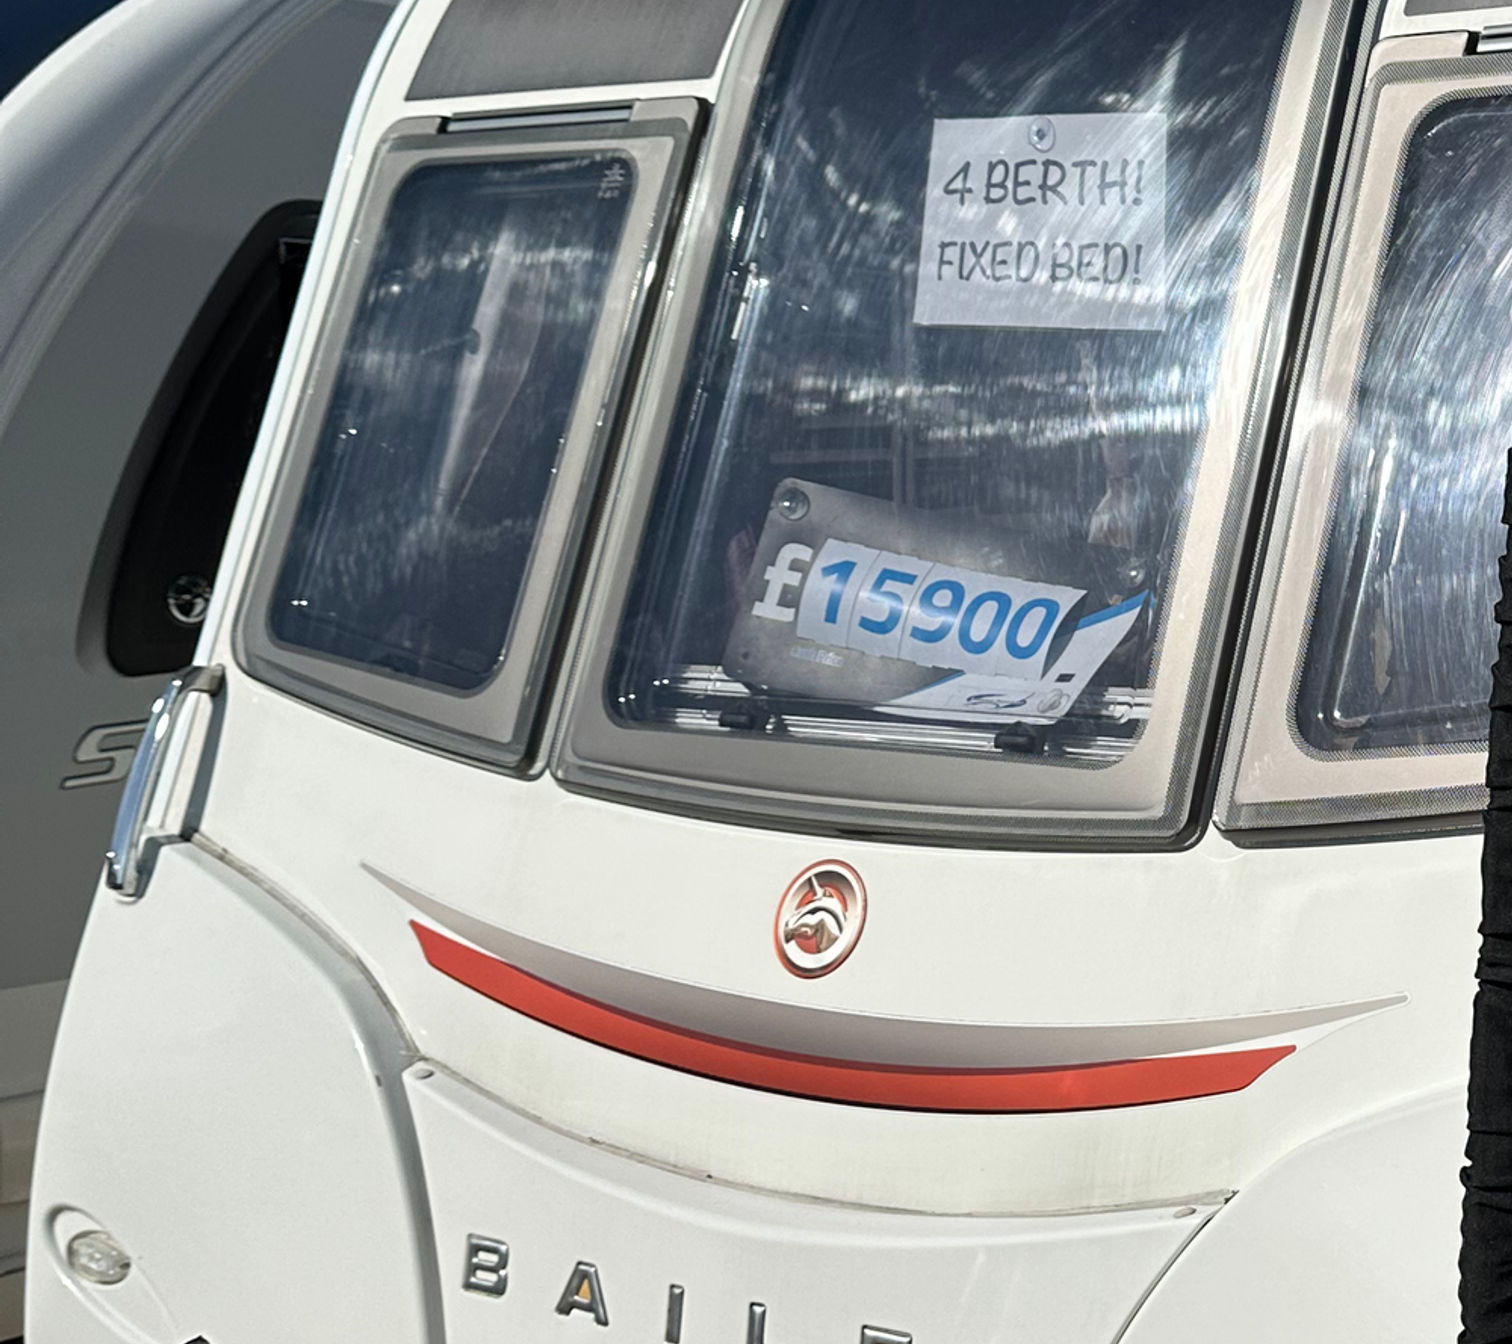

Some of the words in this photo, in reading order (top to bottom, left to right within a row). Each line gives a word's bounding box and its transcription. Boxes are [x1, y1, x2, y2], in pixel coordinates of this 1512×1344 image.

[943, 160, 974, 206] 4
[983, 158, 1146, 206] BERTH!
[937, 239, 1040, 283] FIXED
[1049, 240, 1143, 286] BED!
